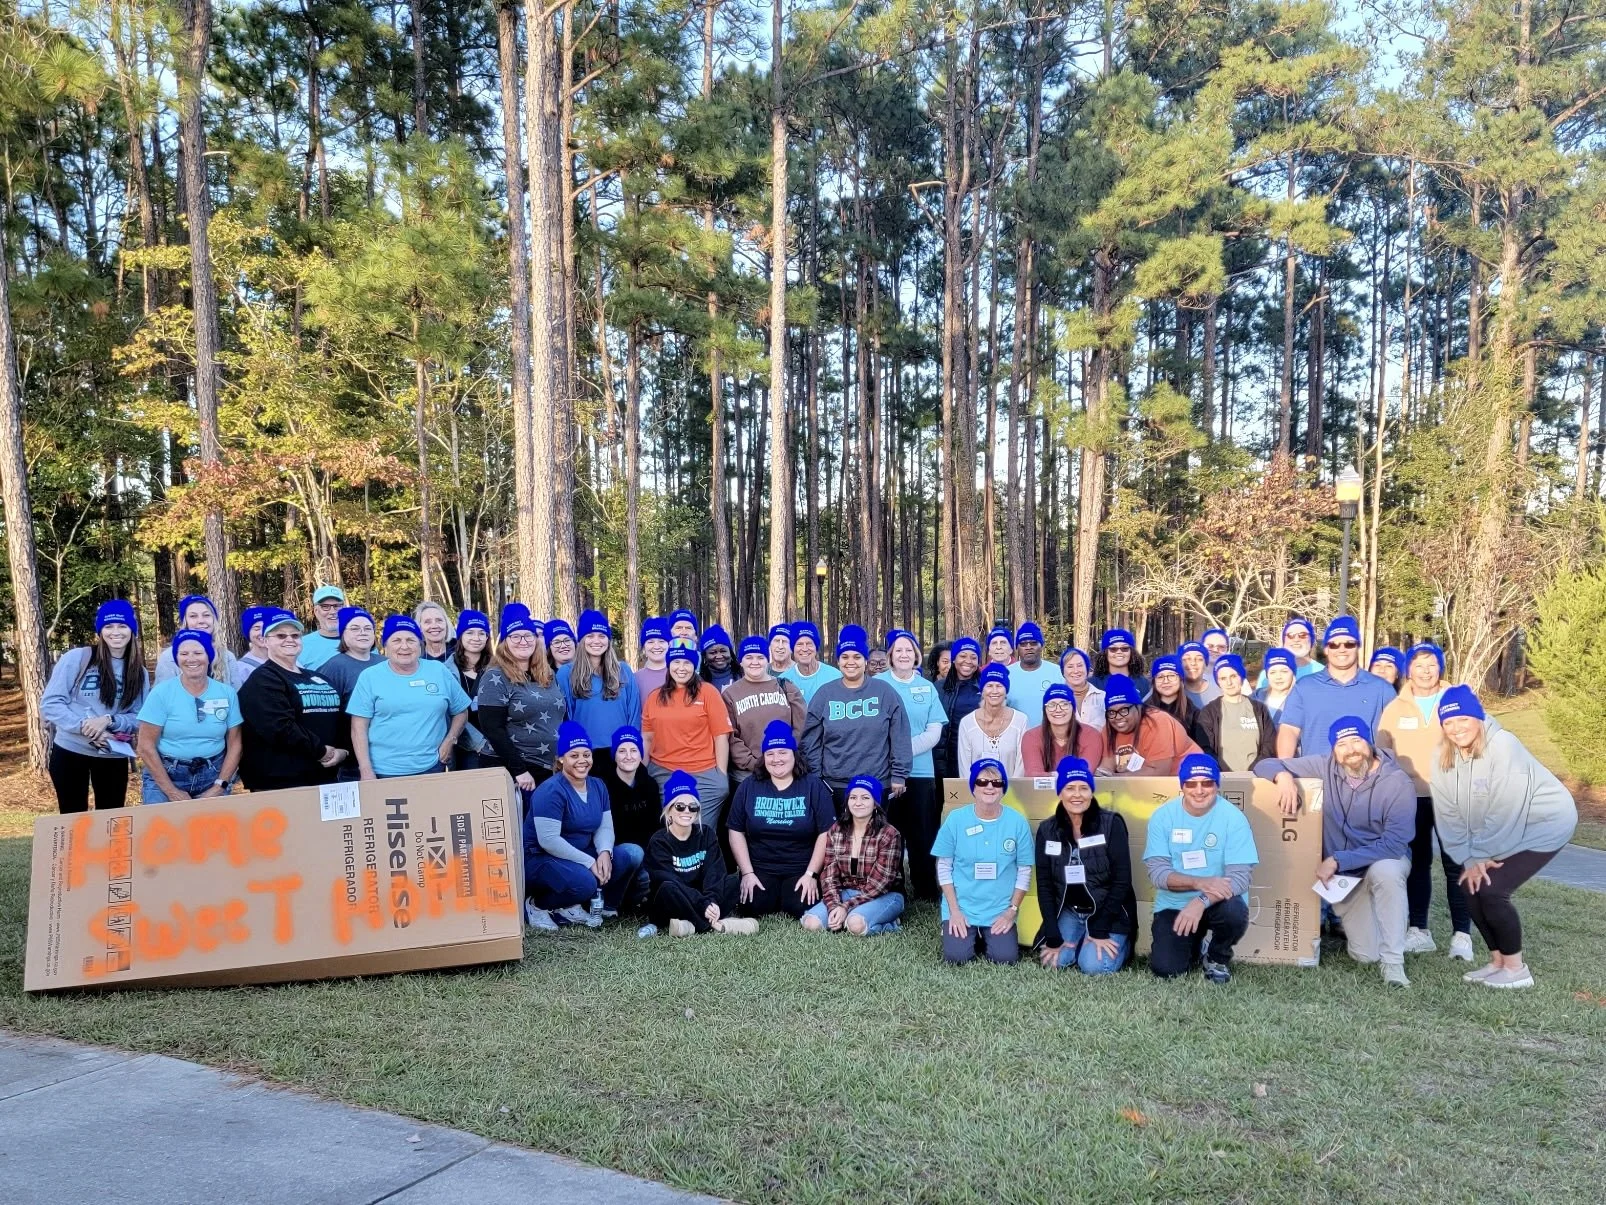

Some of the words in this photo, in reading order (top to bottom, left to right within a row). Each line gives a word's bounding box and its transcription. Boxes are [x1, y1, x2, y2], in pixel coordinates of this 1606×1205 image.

[736, 695, 759, 715] NORTH
[829, 697, 879, 720] BCC
[754, 797, 806, 811] BRUNSWICK
[754, 810, 783, 818] COMMUNITY
[785, 810, 805, 818] COLLEGE
[456, 815, 465, 834] SIDE
[766, 818, 794, 826] Nursing
[1281, 817, 1298, 842] LG
[415, 831, 424, 843] Do
[416, 845, 425, 860] Not
[458, 838, 468, 861] PARTE
[343, 824, 357, 910] REFRIGERADOR
[363, 818, 379, 914] REFRIGERATOR
[385, 798, 411, 928] Hisense
[416, 862, 426, 888] Clamp
[461, 862, 471, 896] LATERAL
[1273, 900, 1281, 951] REFRIGERADOR
